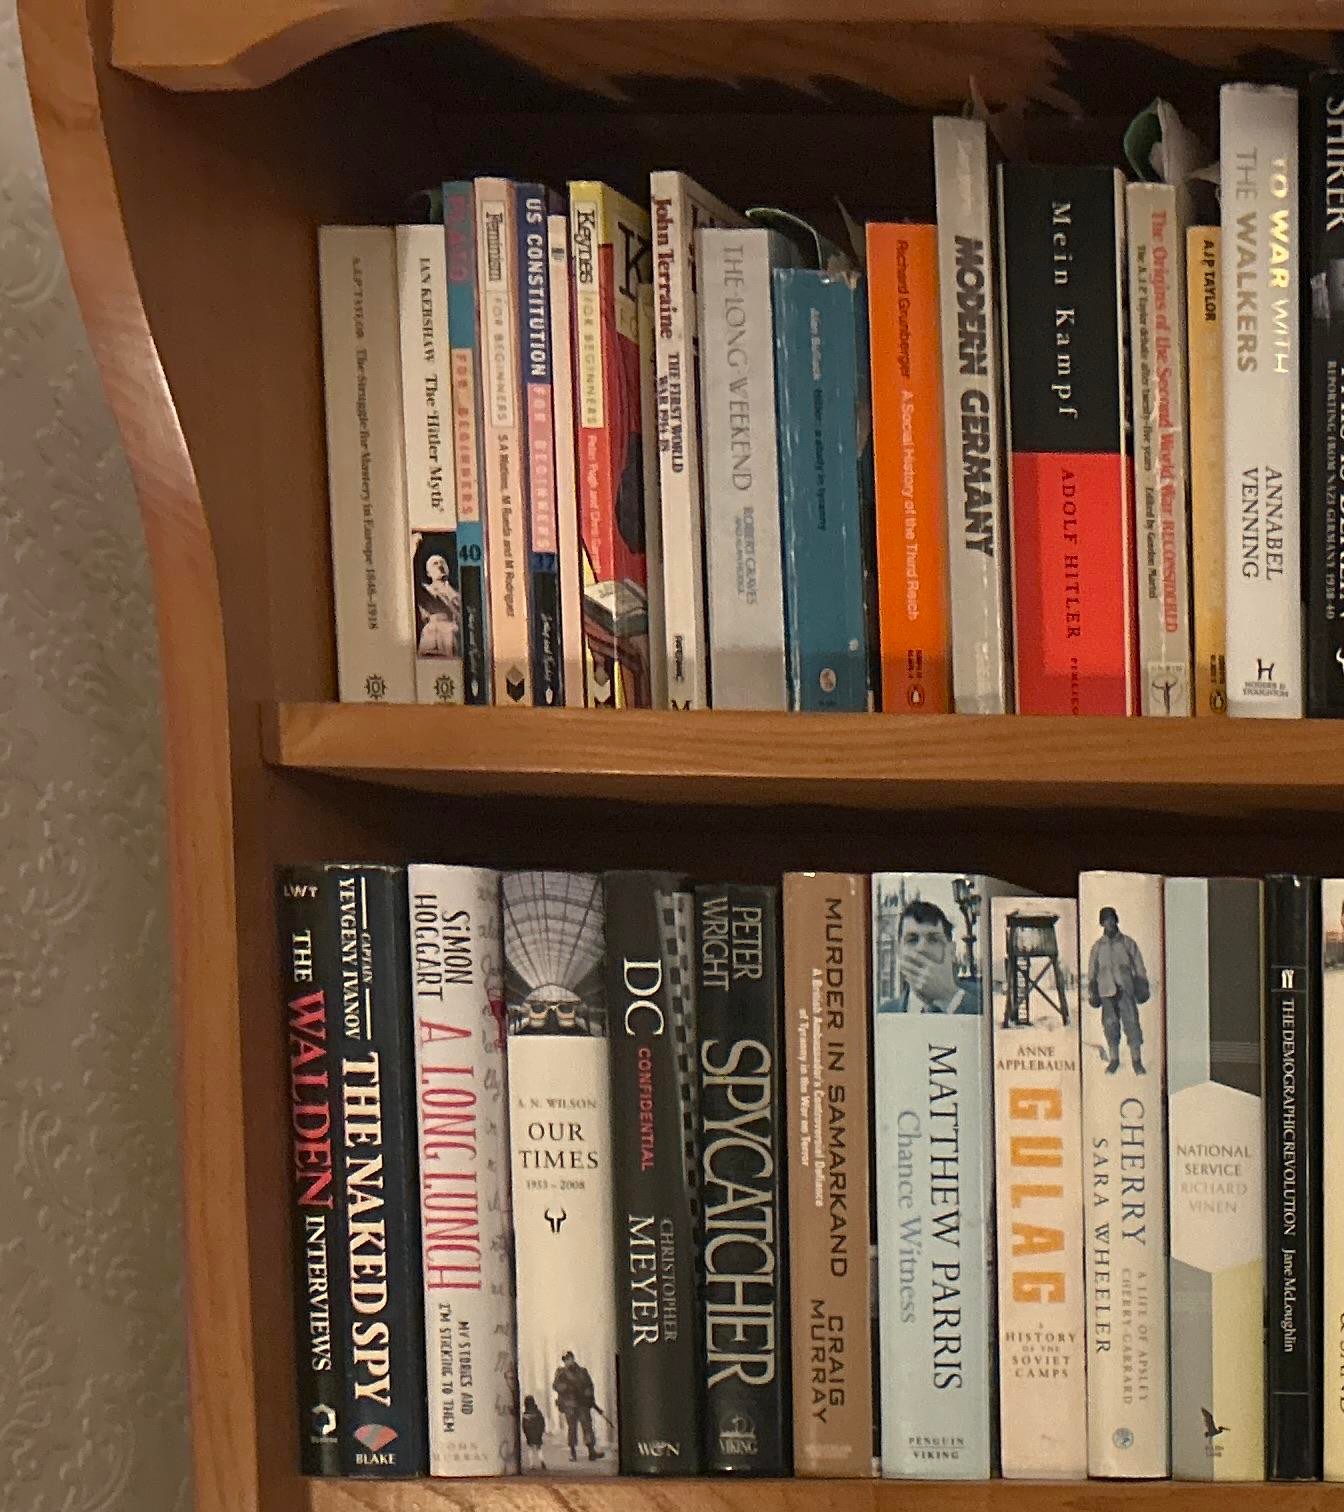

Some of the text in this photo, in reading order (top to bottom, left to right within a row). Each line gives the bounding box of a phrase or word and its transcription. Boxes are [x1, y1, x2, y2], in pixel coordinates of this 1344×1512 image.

[525, 198, 547, 377] US CONSTITUTION
[576, 209, 595, 284] Keynes
[1051, 201, 1078, 421] Mein Kampf
[954, 235, 993, 556] MODERN GERMANY
[1241, 467, 1259, 578] VENNING
[1264, 466, 1286, 579] ANNABEL
[623, 958, 664, 1171] DC CONFIDENTIAL
[997, 1060, 1075, 1071] APPLEBAUM
[1018, 1047, 1055, 1057] ANNE
[288, 930, 333, 1373] THE WALDEN INTERVIEWS
[519, 1151, 599, 1169] TIMES
[528, 1122, 584, 1141] OUR
[1177, 1145, 1251, 1158] NATIONAL
[1184, 1164, 1241, 1176] SERVICE
[341, 1052, 391, 1408] THE NAKED SPY
[701, 1039, 775, 1387] SPYCATCHER
[1008, 1086, 1066, 1305] GULAG
[627, 1214, 658, 1347] MEYER
[355, 1453, 396, 1465] BLAKE
